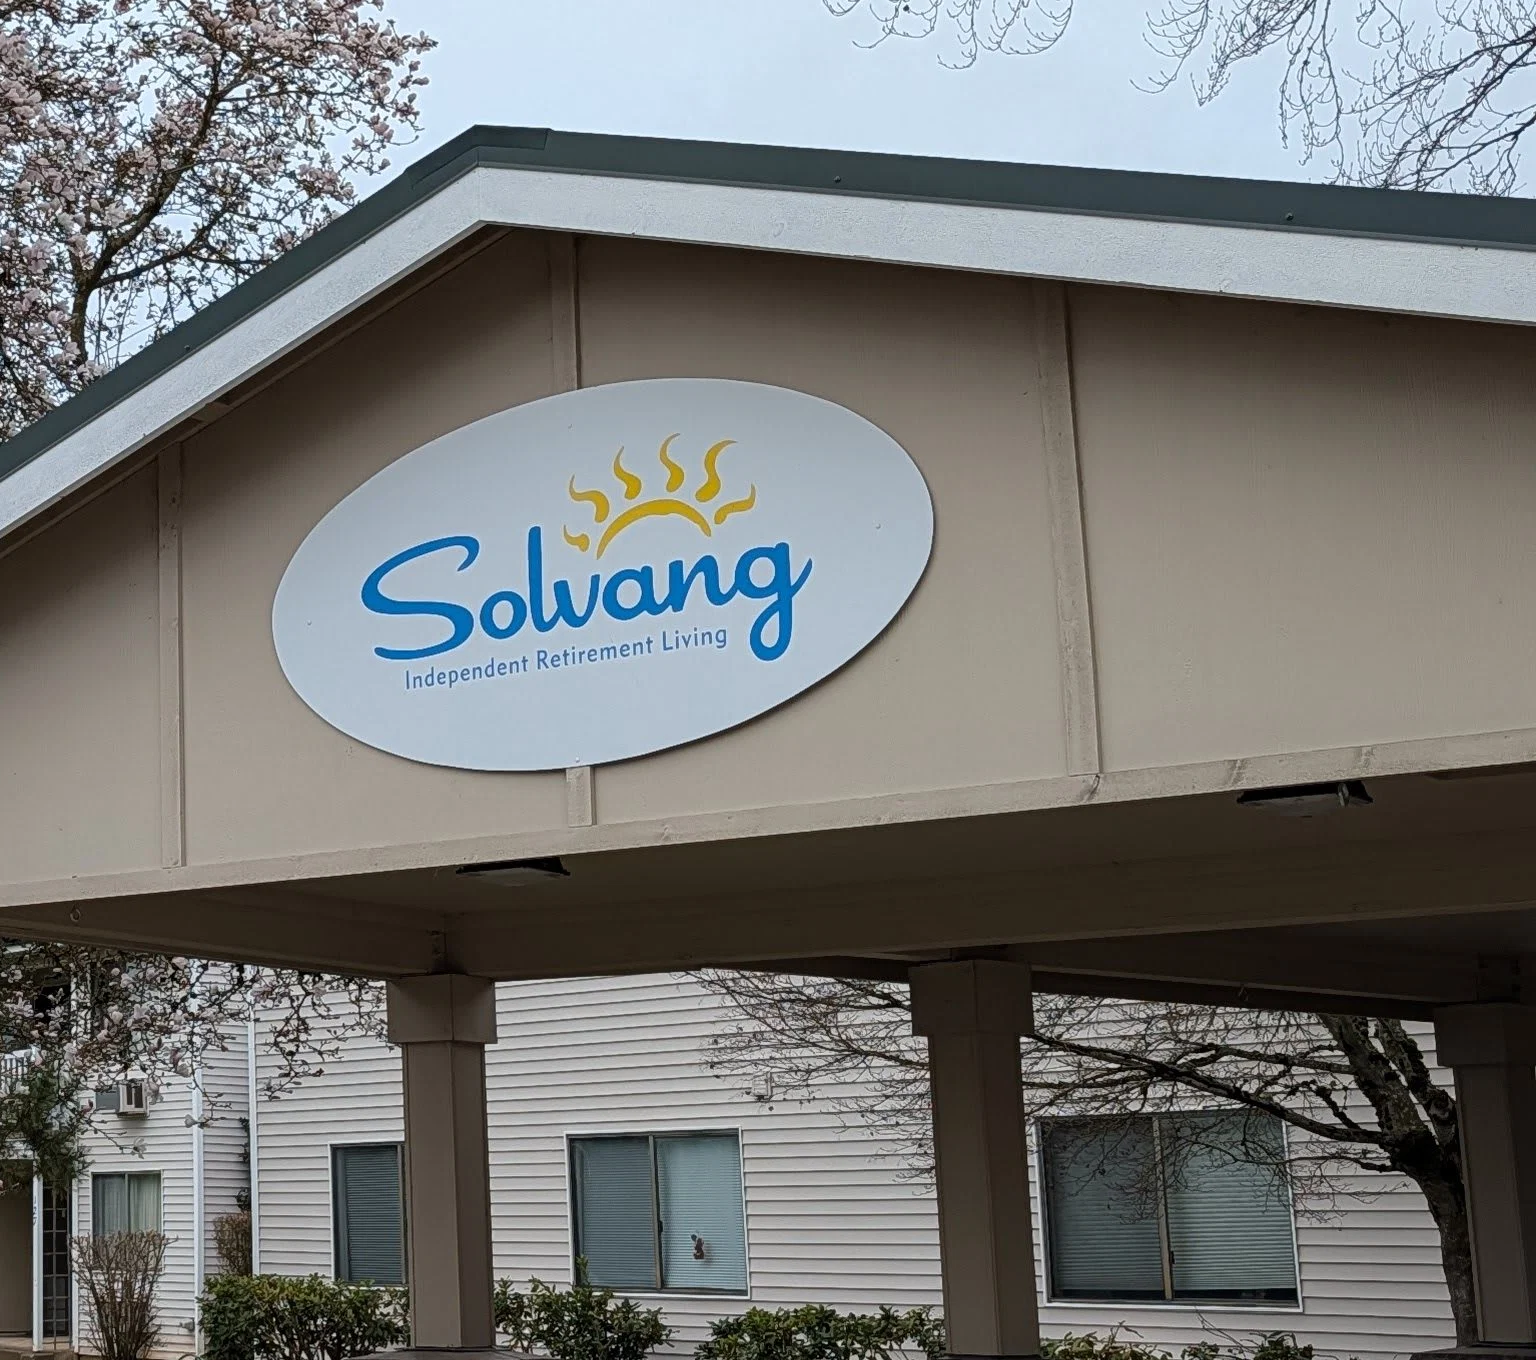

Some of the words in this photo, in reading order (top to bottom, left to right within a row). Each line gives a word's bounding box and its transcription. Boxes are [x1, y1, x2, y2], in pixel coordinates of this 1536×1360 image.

[361, 527, 812, 661] Solvang
[405, 656, 529, 690] Independent
[537, 636, 654, 670] Retirement
[663, 627, 727, 651] Living
